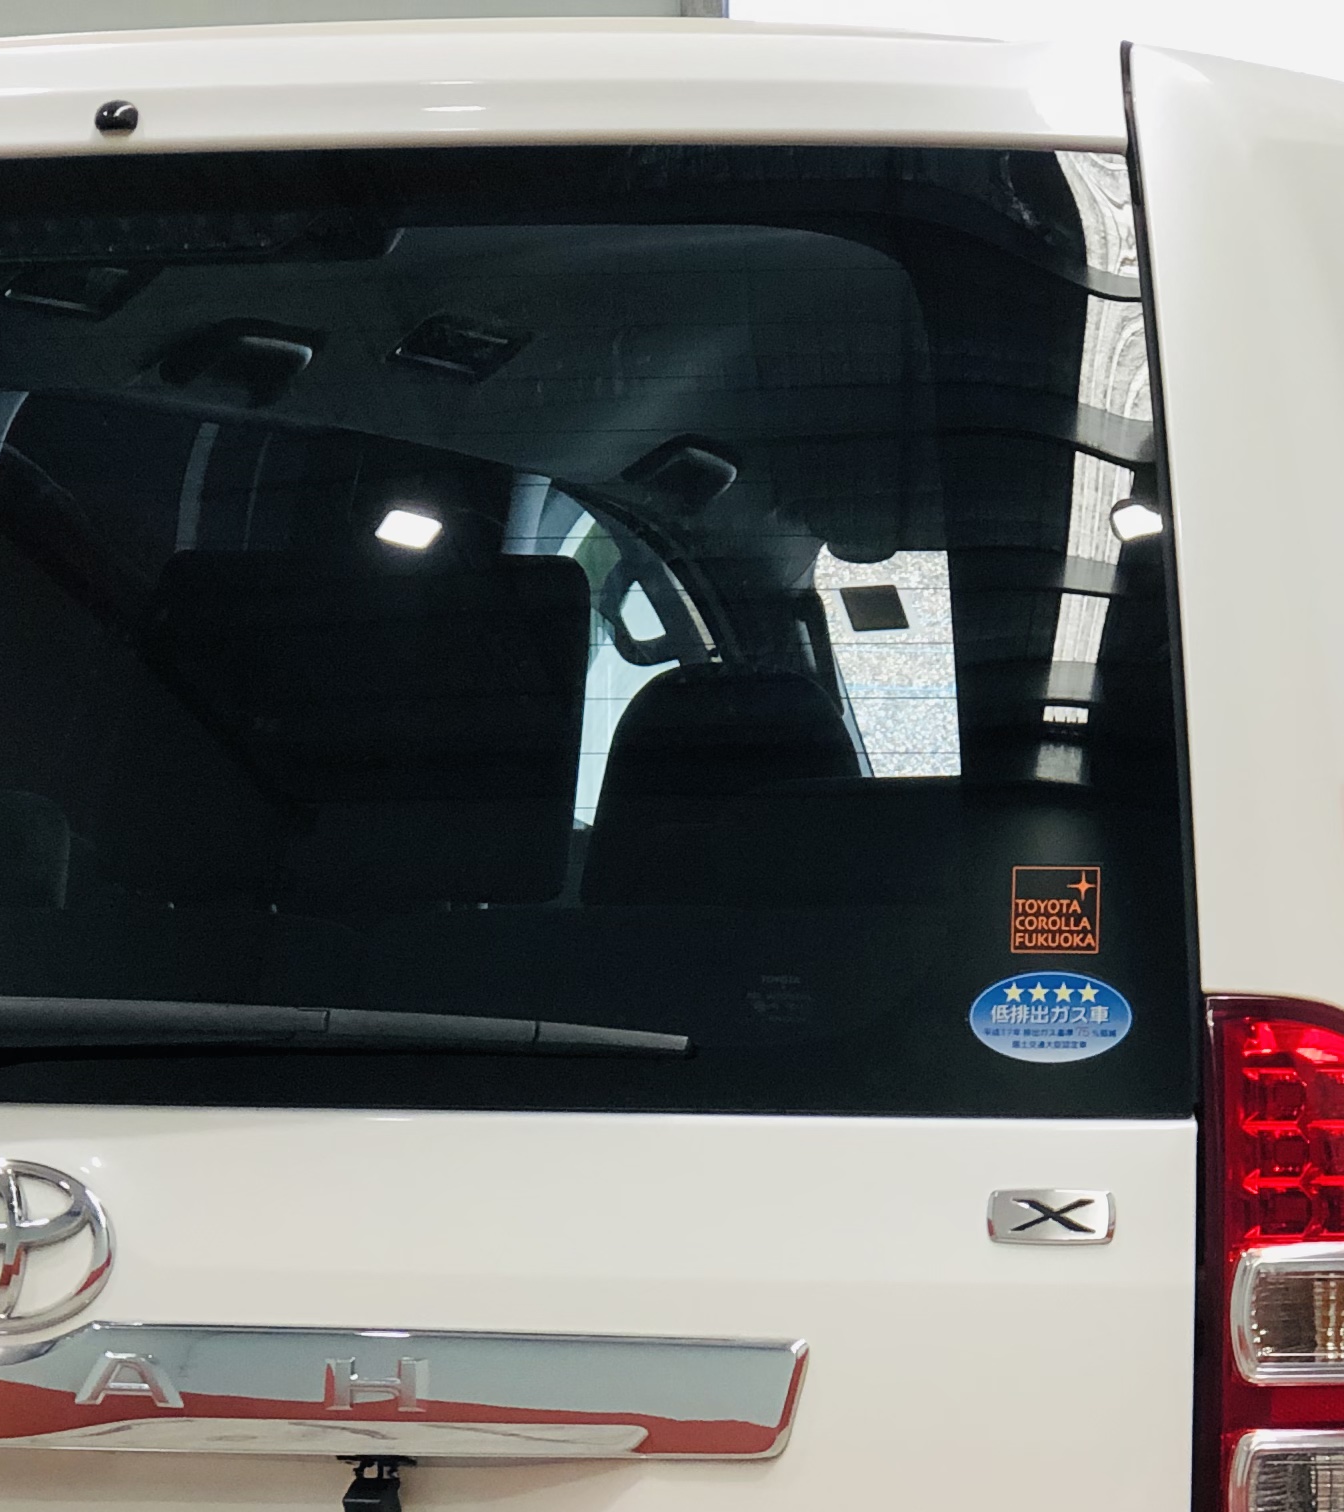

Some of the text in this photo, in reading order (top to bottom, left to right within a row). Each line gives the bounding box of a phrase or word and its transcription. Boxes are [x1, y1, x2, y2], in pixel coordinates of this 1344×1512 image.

[1014, 898, 1082, 914] TOYOTA
[1014, 916, 1092, 931] COROLLA
[1014, 932, 1096, 947] FUKUOKA
[991, 1004, 1110, 1025] 低排出ガス車
[1010, 1197, 1097, 1234] X
